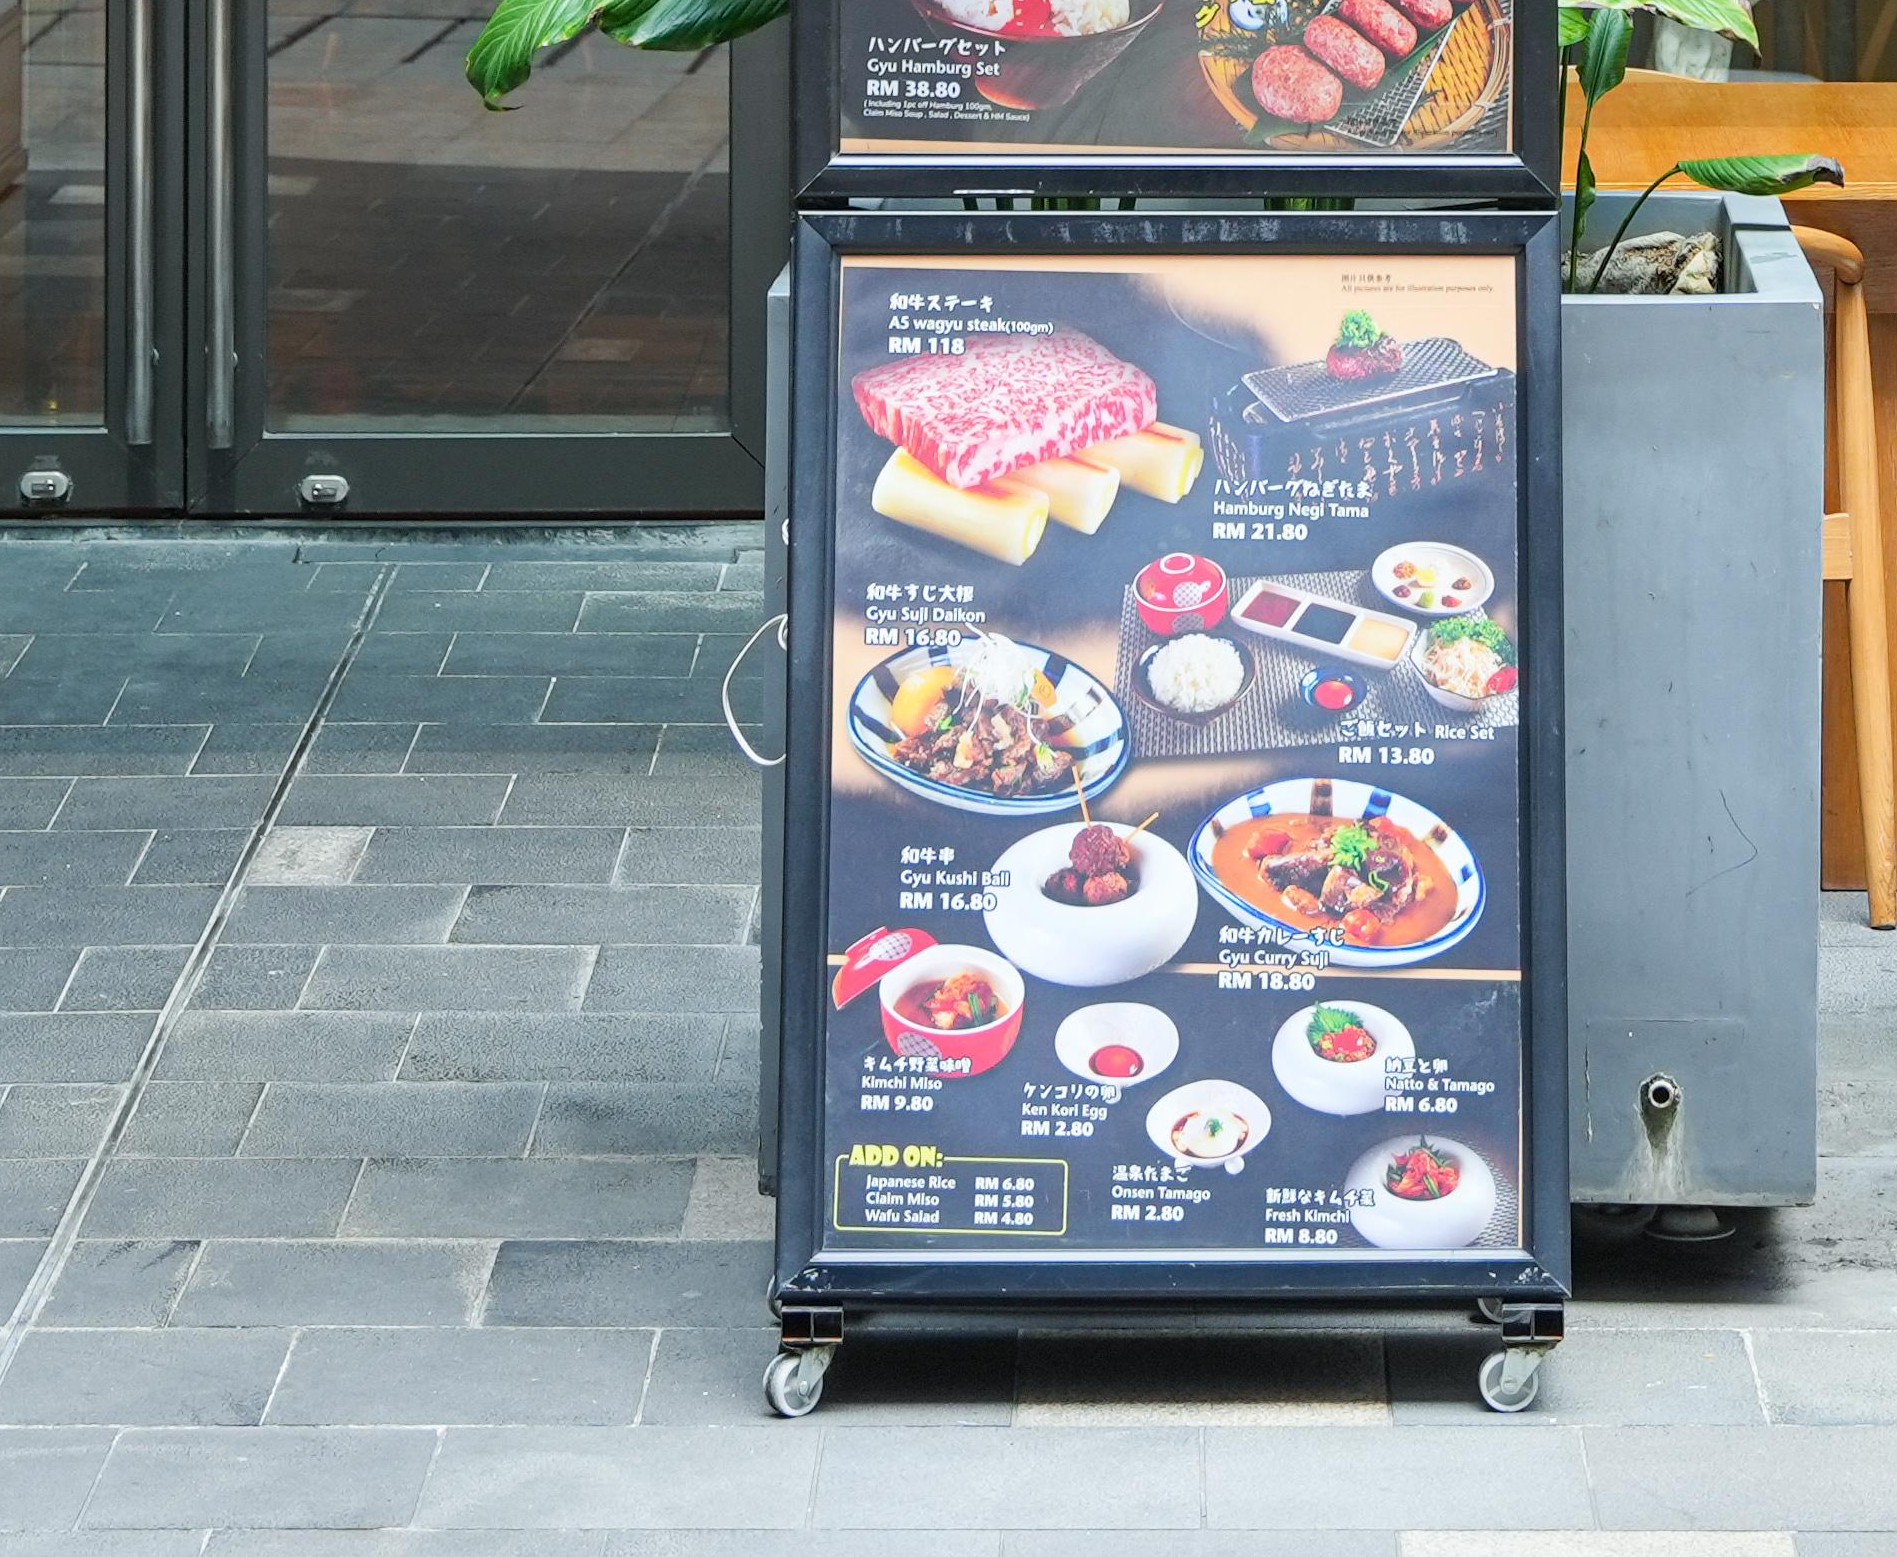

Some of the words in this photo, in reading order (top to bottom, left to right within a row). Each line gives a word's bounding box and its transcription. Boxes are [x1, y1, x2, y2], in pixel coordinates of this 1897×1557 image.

[868, 36, 1006, 57] ハンバーグセット
[867, 58, 897, 76] Gyu
[901, 59, 972, 79] Hamburg
[975, 61, 1000, 76] Set
[866, 79, 899, 97] RM
[905, 80, 961, 98] 38.80
[889, 292, 994, 313] 和牛ステーキ
[888, 315, 910, 331] A5
[913, 317, 963, 334] wagyu
[888, 337, 921, 354] RM
[927, 337, 965, 355] 118
[1213, 501, 1284, 519] Hamburg
[1288, 503, 1324, 521] Negi
[1328, 503, 1370, 518] Tama
[1212, 523, 1245, 540] RM
[1251, 523, 1308, 541] 21.80
[866, 606, 897, 623] Gyu
[901, 607, 928, 624] Suji
[932, 607, 986, 623] Daikon
[865, 628, 898, 645] RM
[905, 629, 962, 647] 16.80
[1435, 724, 1467, 740] Rice
[1471, 725, 1495, 741] Set
[1338, 746, 1371, 764] RM
[1378, 747, 1435, 765] 13.80
[900, 869, 932, 886] Gyu
[935, 870, 978, 886] Kushi
[982, 870, 1010, 886] Ball
[899, 891, 932, 909] RM
[939, 892, 997, 911] 16.80
[1219, 949, 1250, 967] Gyu
[1254, 949, 1298, 968] Curry
[1301, 950, 1330, 969] Suji
[1218, 972, 1252, 989] RM
[1258, 973, 1316, 991] 18.80
[861, 1075, 907, 1090] Kimchi
[910, 1076, 942, 1090] Miso
[1386, 1077, 1424, 1093] Natto
[1428, 1079, 1439, 1092] &
[1442, 1079, 1495, 1095] Tamago
[860, 1095, 890, 1111] RM
[894, 1096, 933, 1112] 9.80
[1022, 1103, 1047, 1116] Ken
[1051, 1104, 1079, 1118] Kori
[1082, 1105, 1108, 1121] Egg
[1385, 1096, 1414, 1112] RM
[1419, 1097, 1458, 1113] 6.80
[1021, 1121, 1050, 1136] RM
[1054, 1121, 1094, 1137] 2.80
[849, 1145, 900, 1167] ADD
[903, 1146, 944, 1168] ON:
[1111, 1185, 1155, 1201] Onsen
[1159, 1187, 1211, 1203] Tamago
[1111, 1204, 1140, 1220] RM
[1145, 1205, 1184, 1222] 2.80
[1265, 1208, 1301, 1224] Fresh
[1304, 1209, 1350, 1224] Kimchi
[1264, 1228, 1294, 1244] RM
[1298, 1229, 1338, 1246] 8.80
